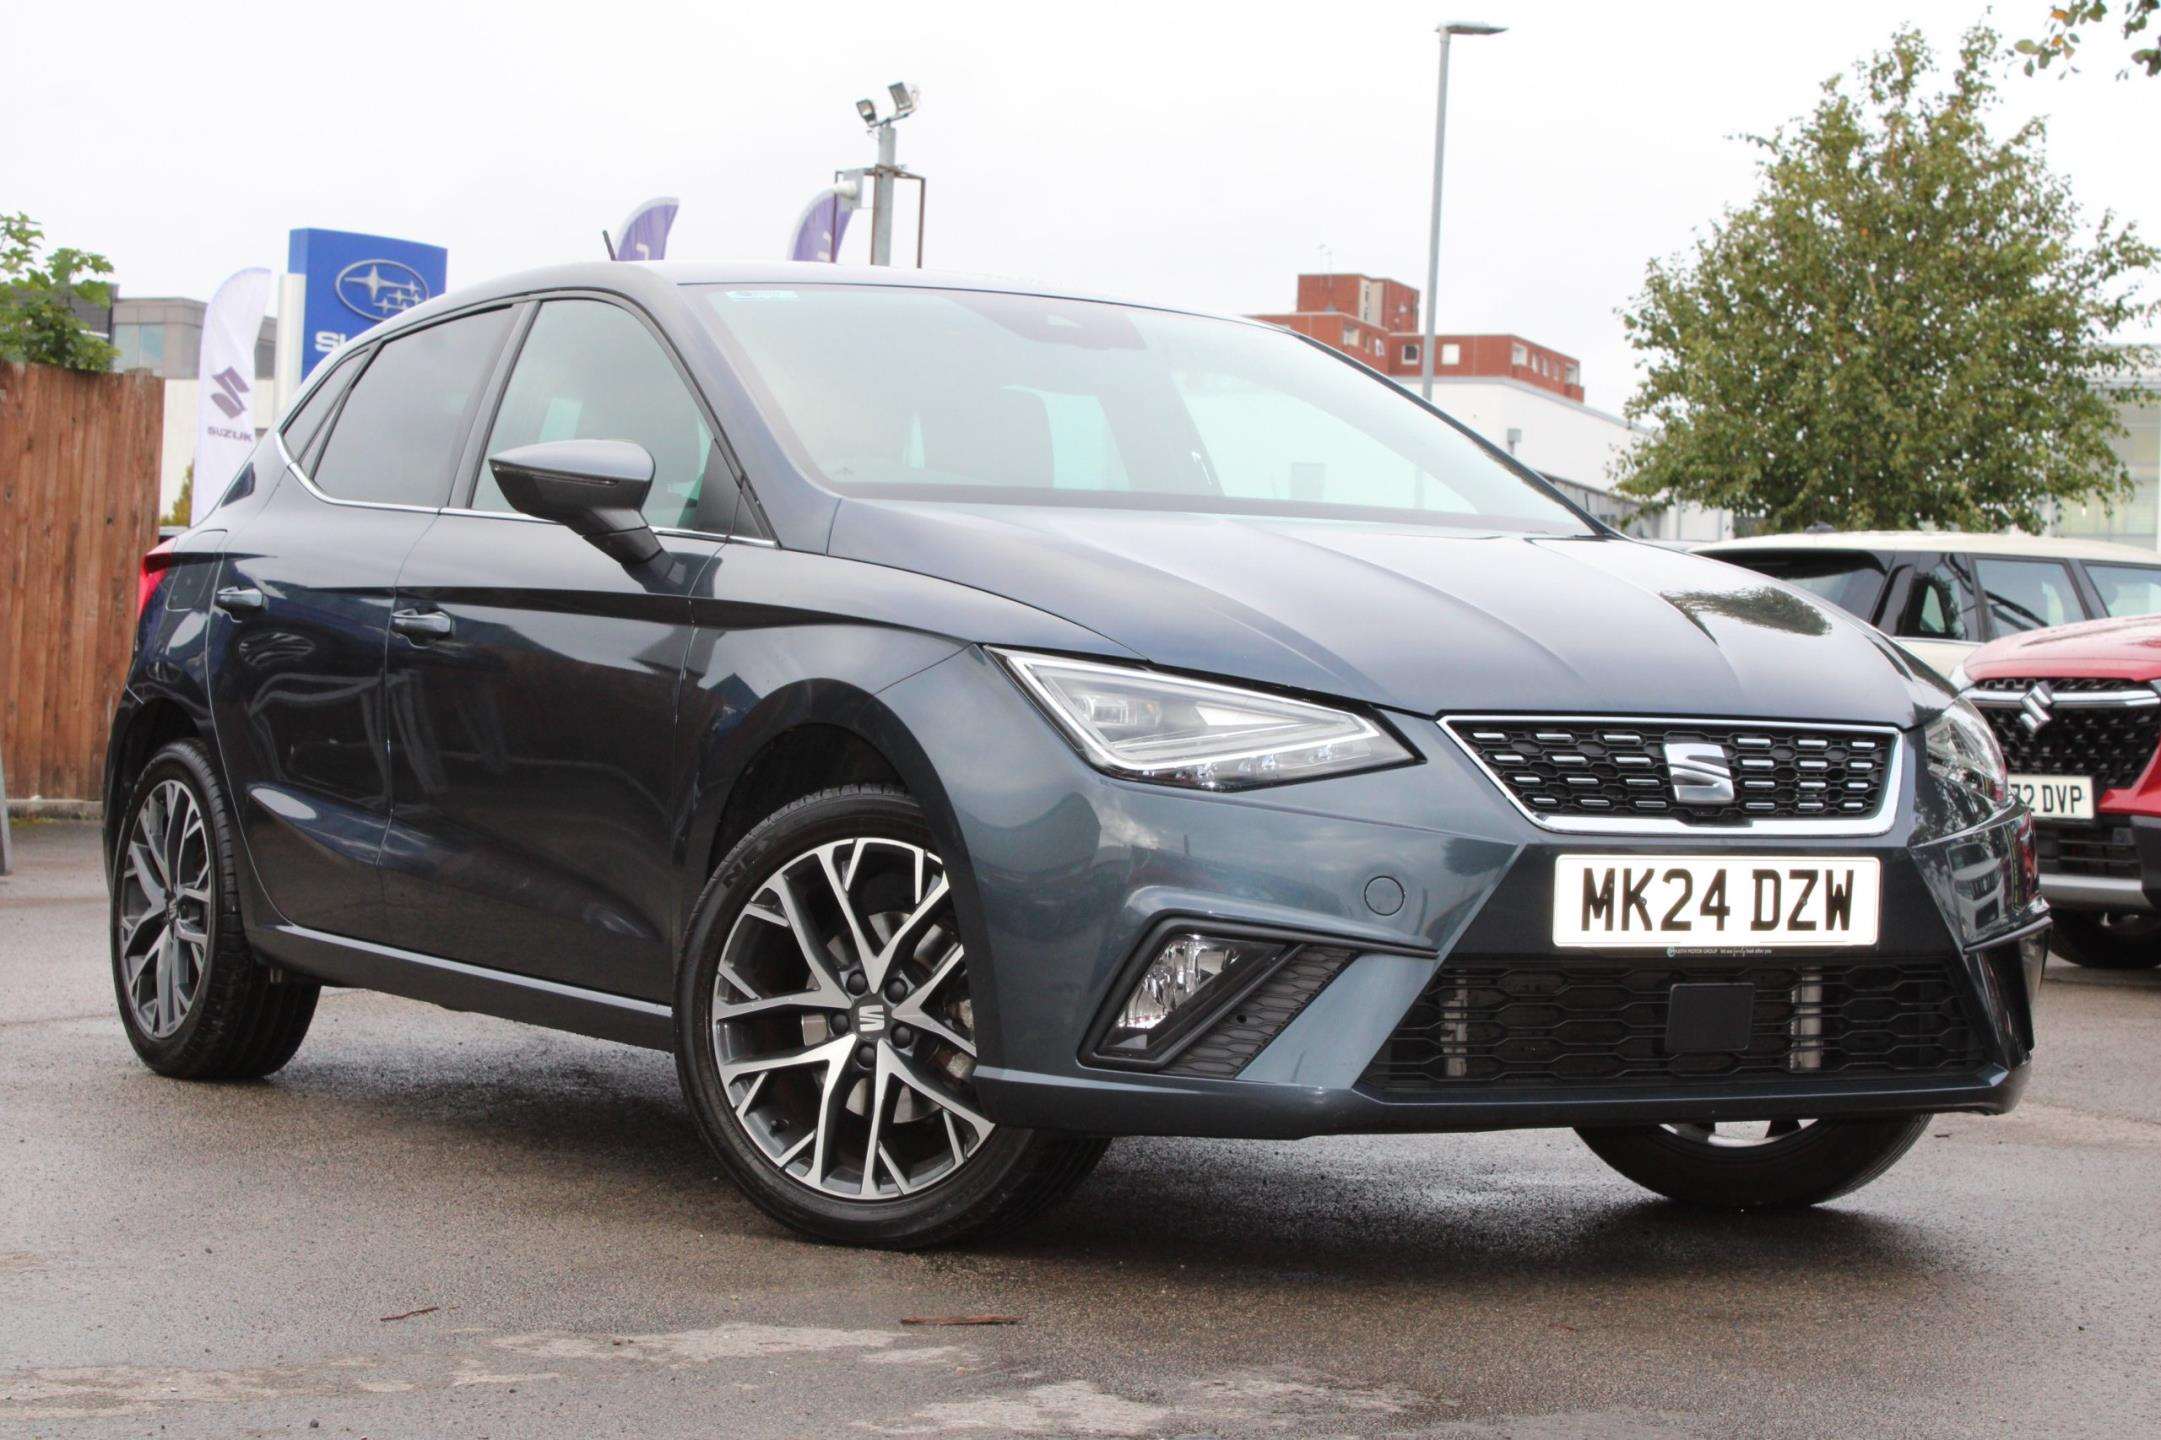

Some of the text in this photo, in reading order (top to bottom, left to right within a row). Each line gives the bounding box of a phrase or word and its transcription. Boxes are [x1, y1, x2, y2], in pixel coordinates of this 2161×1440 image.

[2042, 784, 2082, 813] DVP
[1581, 867, 1854, 931] MK24 DZW
